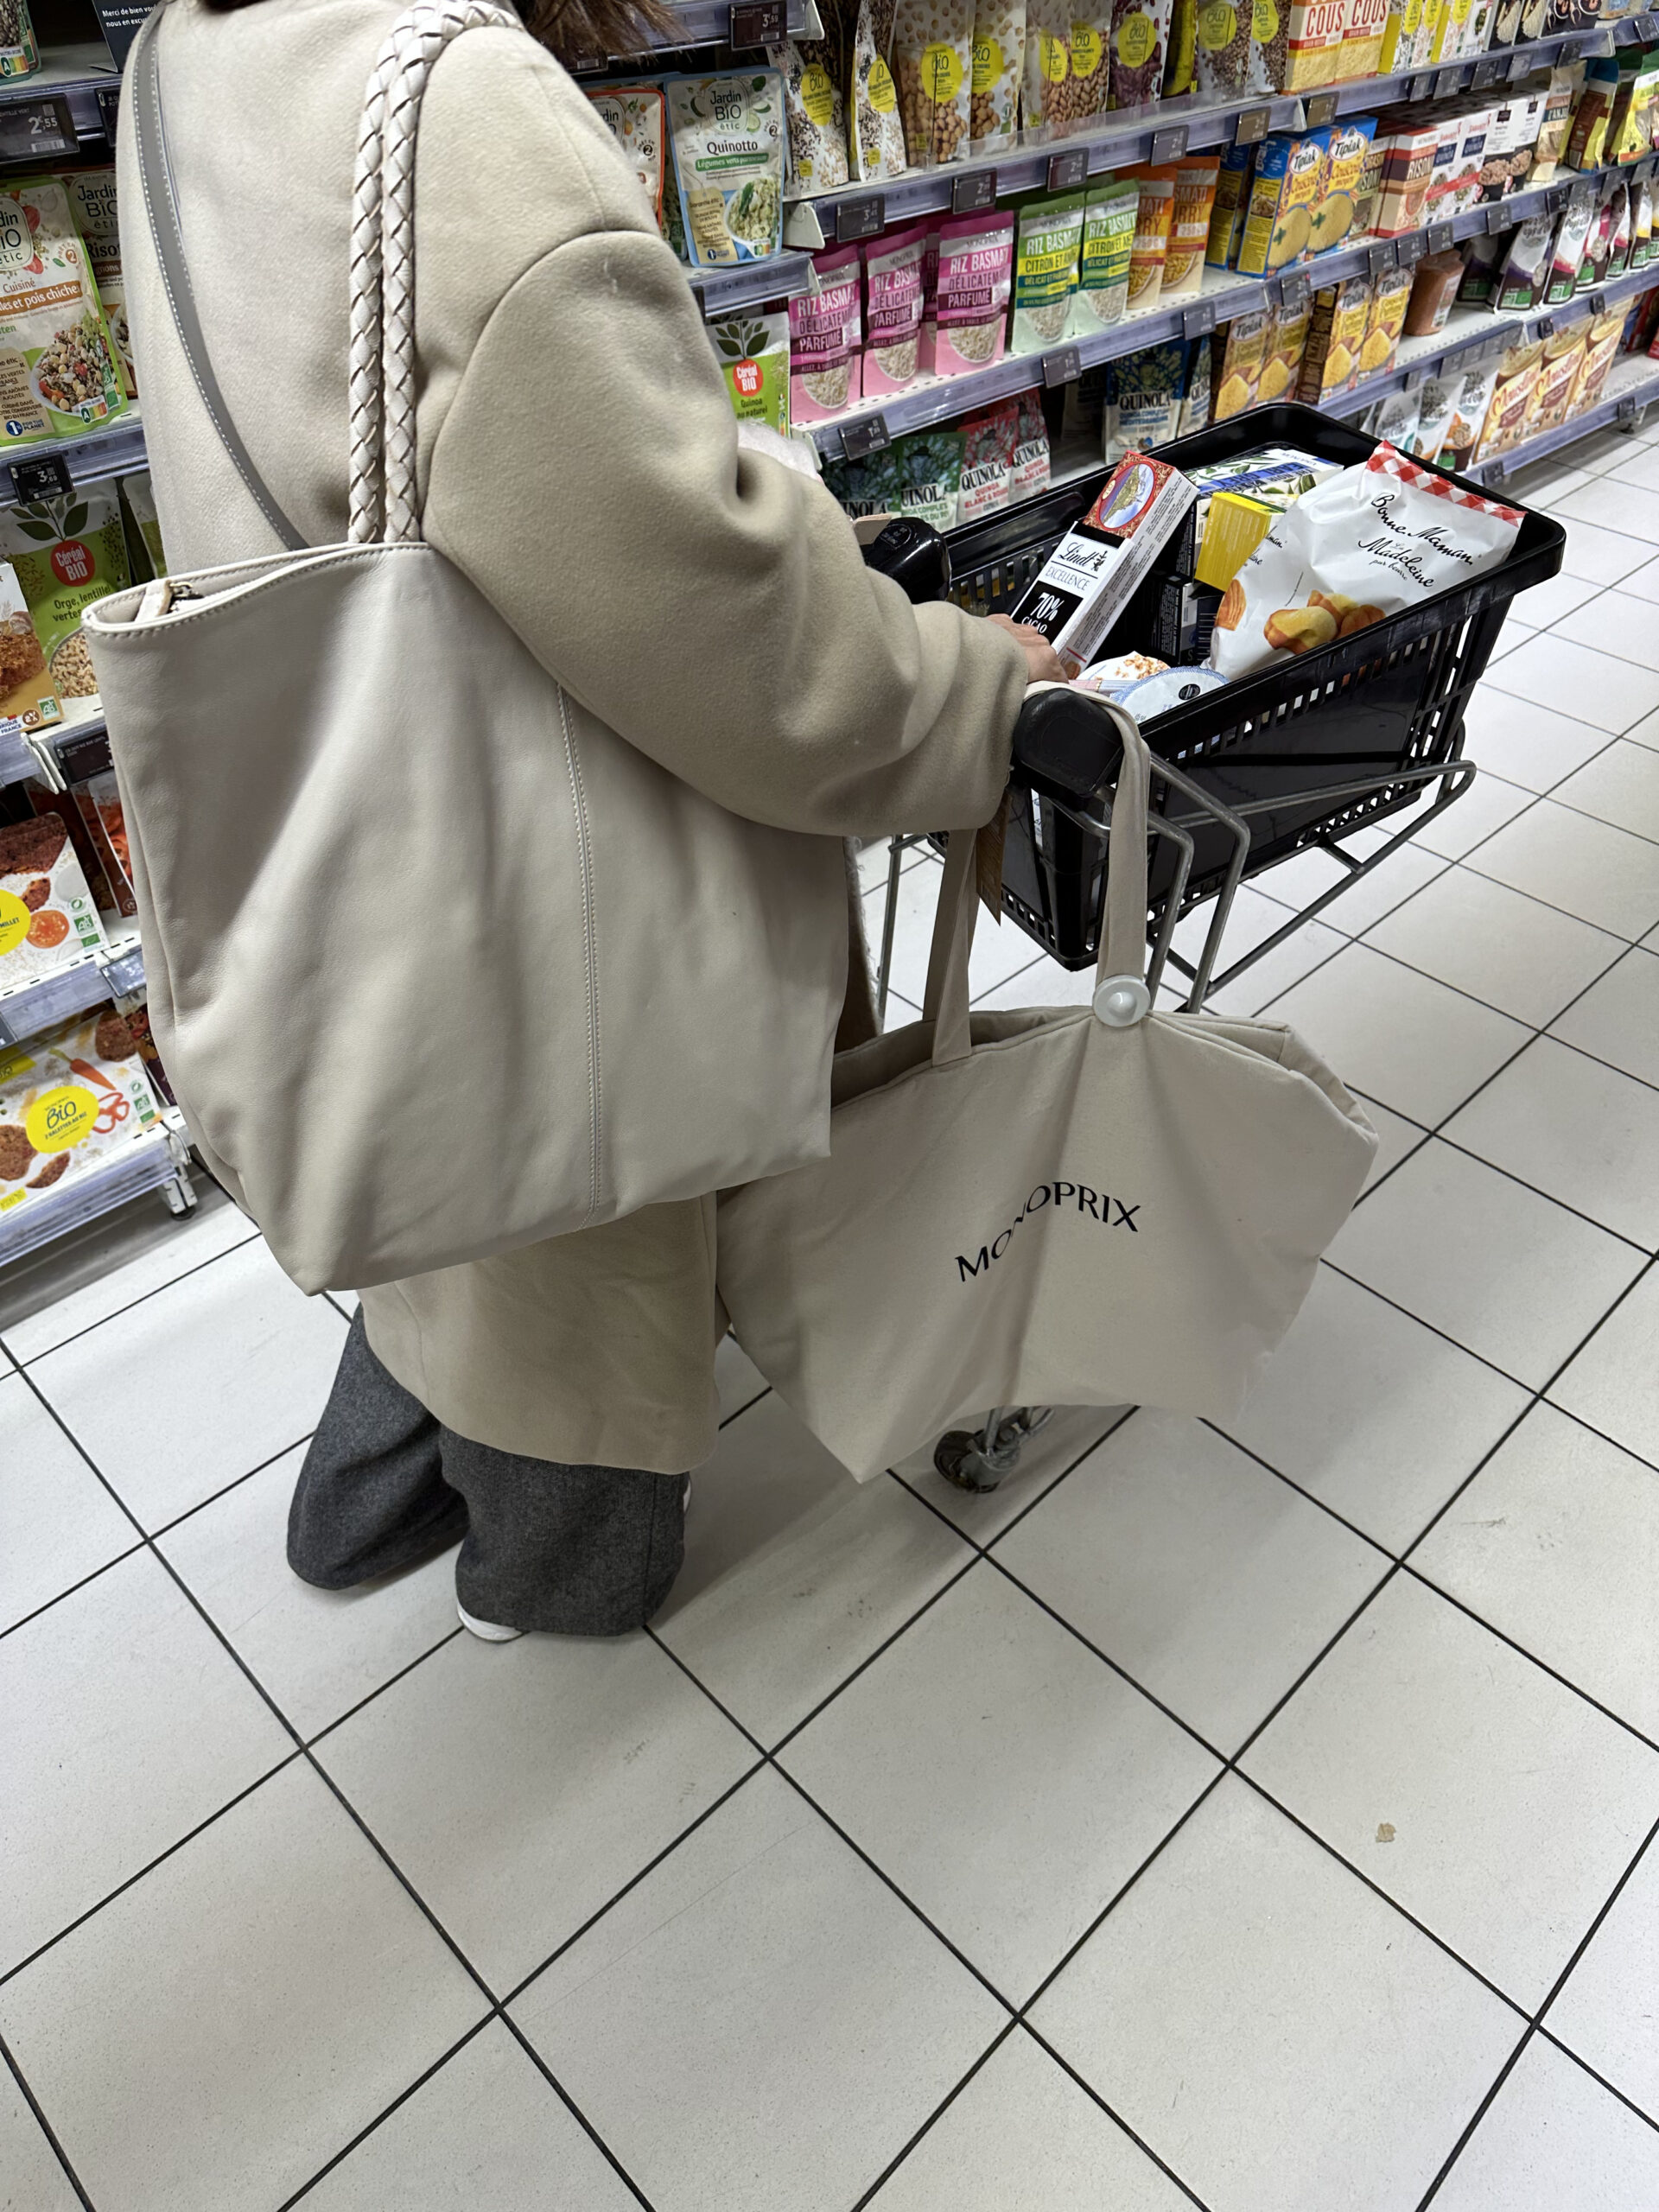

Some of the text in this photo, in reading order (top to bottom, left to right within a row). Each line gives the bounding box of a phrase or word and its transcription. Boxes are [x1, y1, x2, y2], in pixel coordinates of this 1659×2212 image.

[102, 8, 120, 17] Merci
[121, 7, 129, 16] de
[130, 5, 143, 15] bien
[1306, 3, 1344, 37] COUS
[710, 89, 741, 105] Jardin
[715, 104, 741, 121] BiO
[707, 140, 758, 156] Quinotto
[1335, 137, 1361, 158] Tipiak
[696, 157, 725, 169] Légumes
[1027, 236, 1044, 256] RIZ
[951, 256, 969, 276] RIZ
[1026, 256, 1053, 274] CITRON
[3, 278, 36, 294] Cuisiné
[874, 274, 891, 293] RIZ
[13, 297, 23, 308] et
[24, 292, 46, 308] pois
[798, 298, 818, 317] RIZ
[737, 364, 758, 379] Céréal
[741, 376, 757, 392] BIO
[741, 397, 763, 409] Quinoa
[1120, 391, 1172, 410] QUINOLA
[1013, 439, 1050, 468] QUINOLA
[961, 463, 1006, 492] QUINOLA
[964, 495, 987, 509] BLANC
[1371, 492, 1408, 535] Bonne
[55, 545, 86, 568] Céréal
[1058, 542, 1100, 568] Lindt
[1358, 537, 1434, 588] Madeleine
[66, 561, 88, 581] BIO
[1045, 566, 1091, 591] EXCELLENCE
[54, 598, 79, 610] Orge,
[1030, 592, 1065, 622] 70%
[53, 608, 82, 623] vertes
[1, 723, 22, 734] FRANCE
[47, 1100, 77, 1130] BiO
